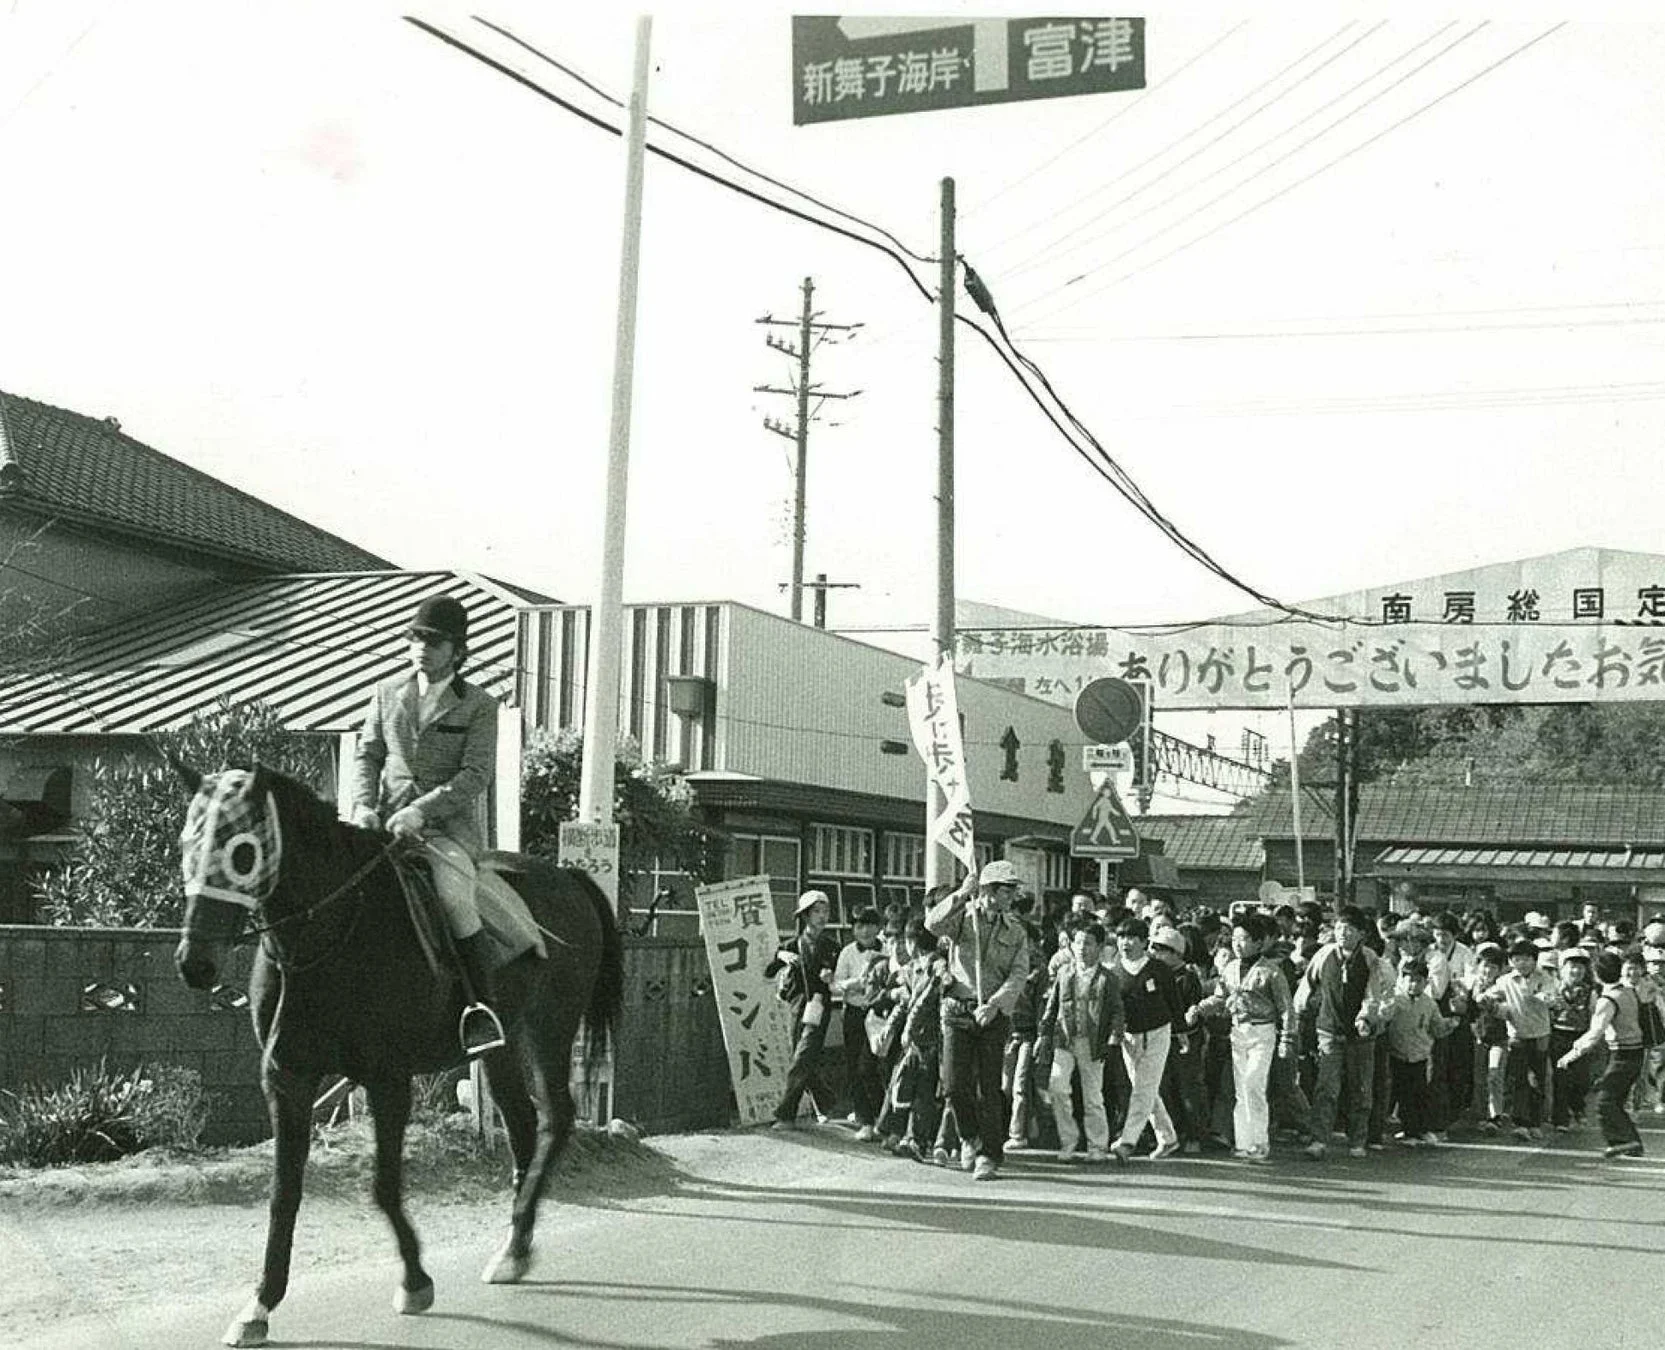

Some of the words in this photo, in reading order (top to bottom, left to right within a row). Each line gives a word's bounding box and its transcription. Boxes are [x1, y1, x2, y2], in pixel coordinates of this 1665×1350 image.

[803, 45, 961, 106] 新舞子海岸
[1023, 18, 1135, 81] 富津
[1382, 585, 1665, 623] 南房総国定
